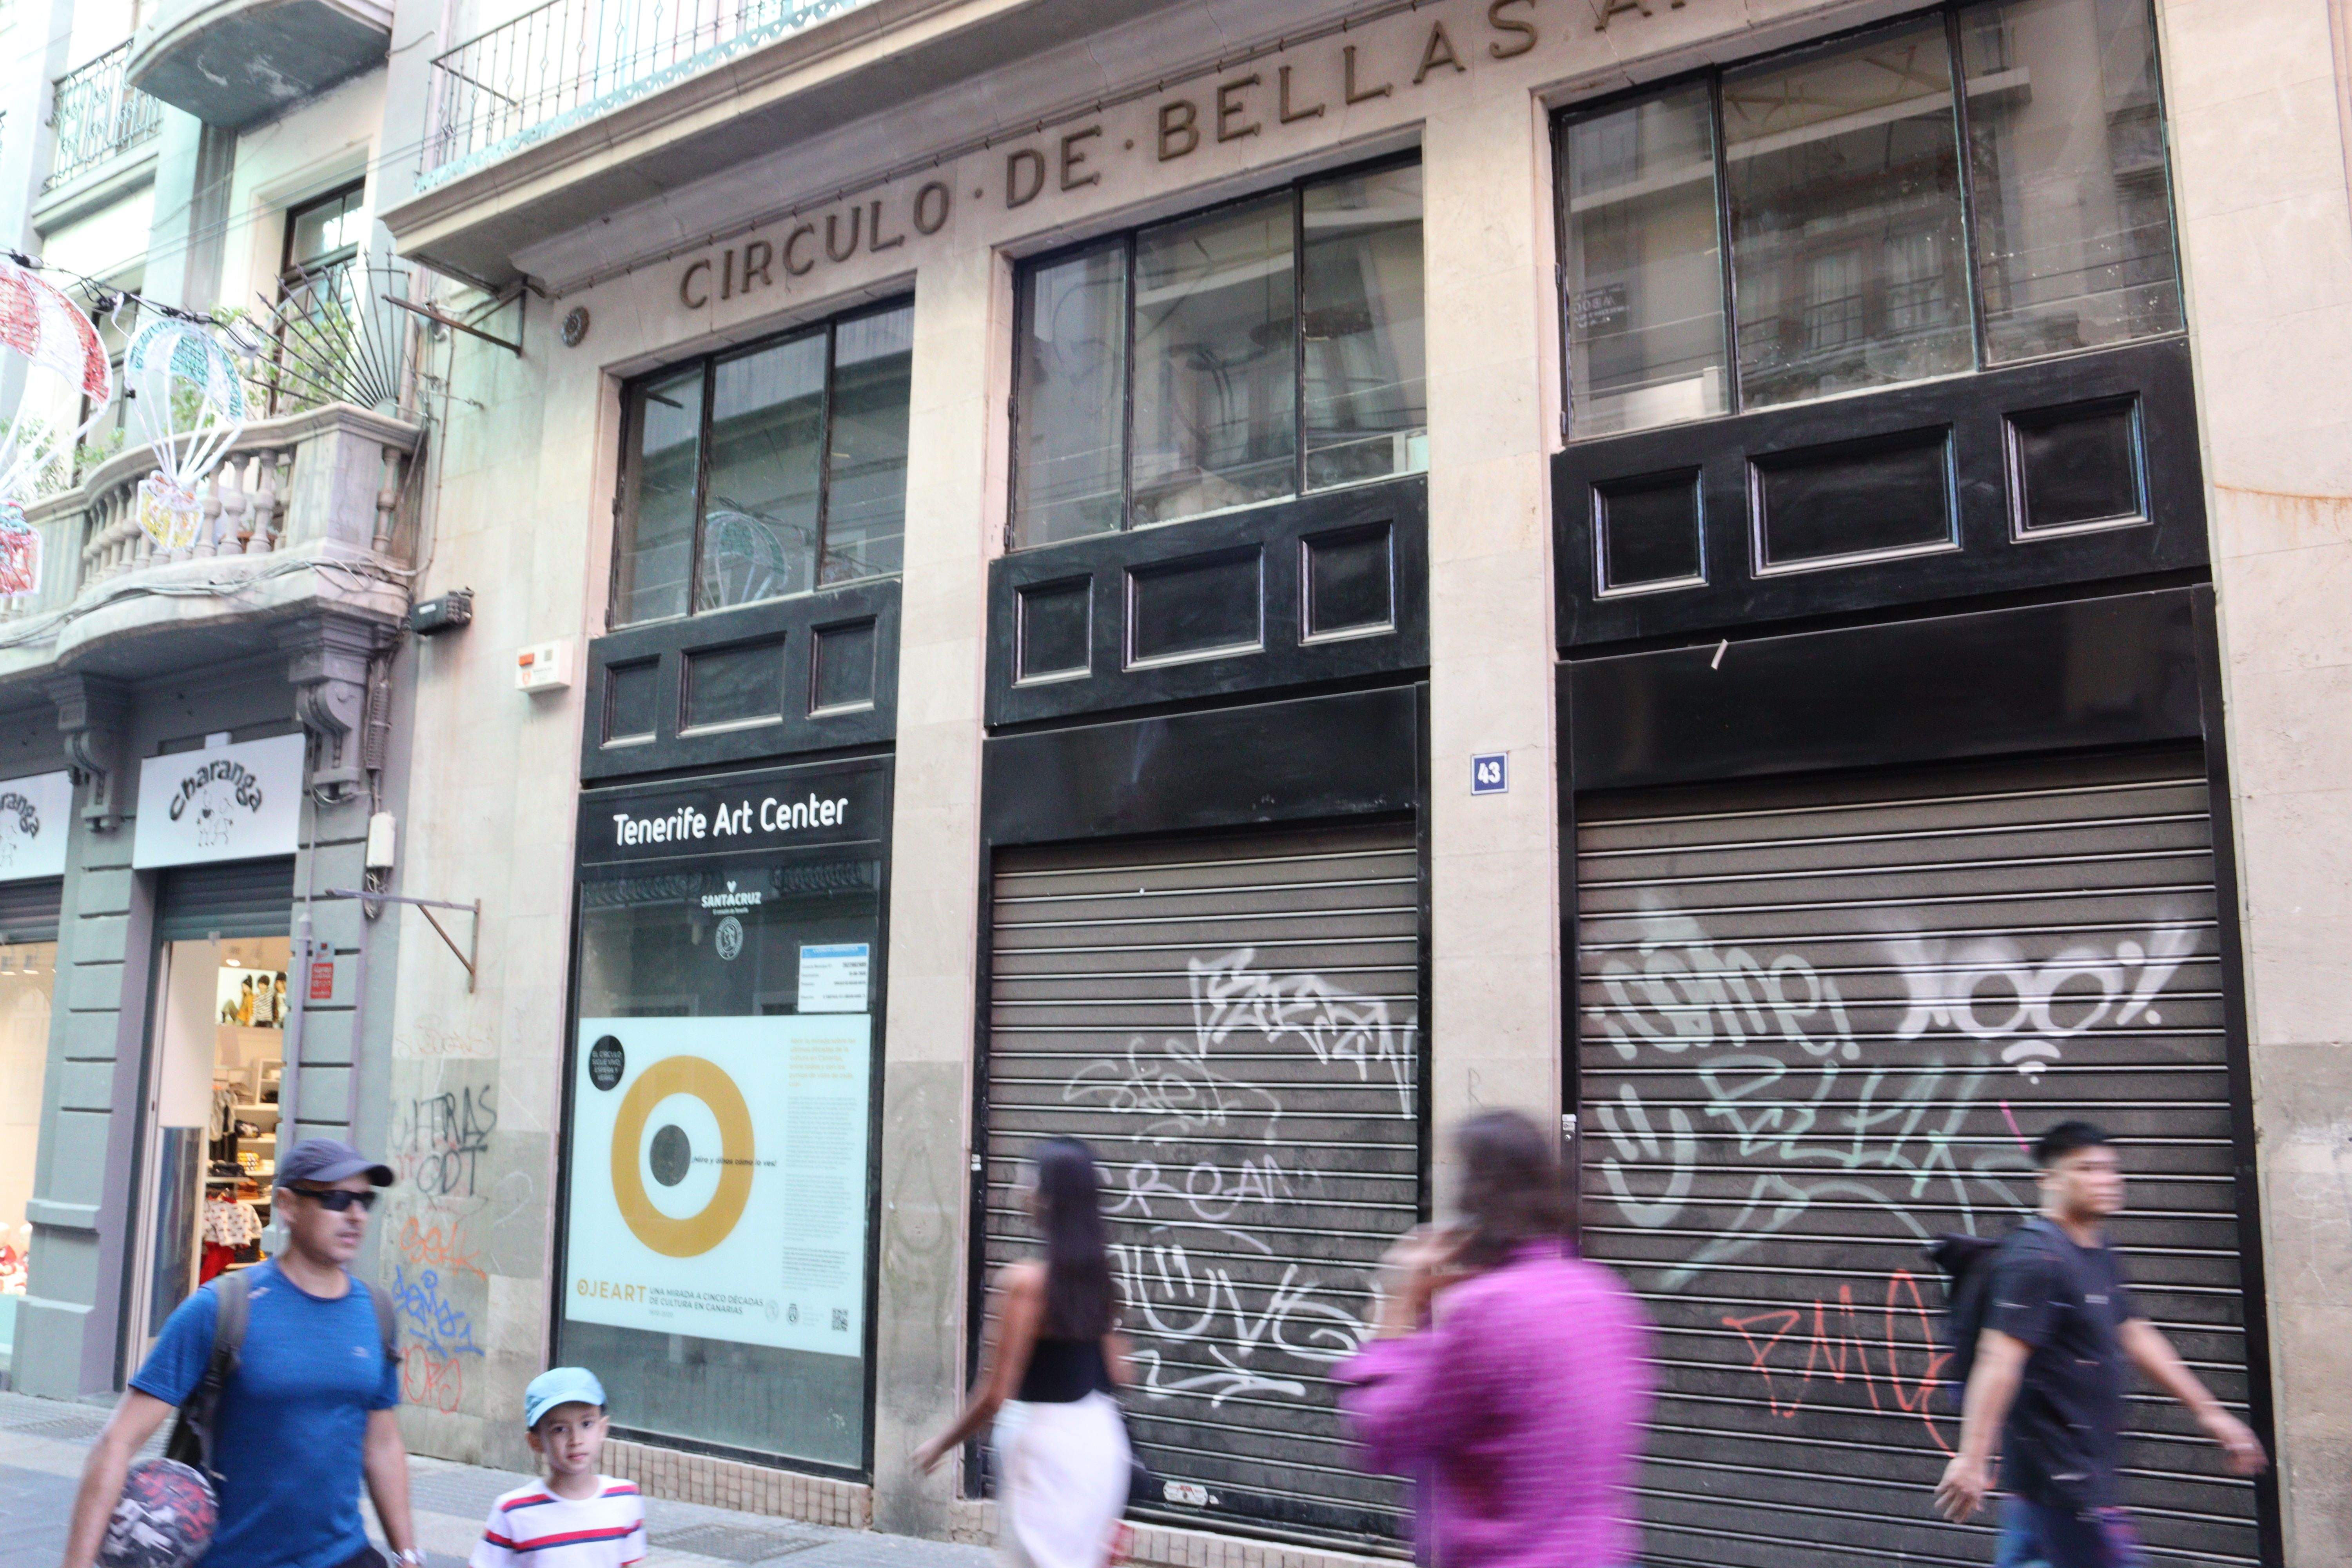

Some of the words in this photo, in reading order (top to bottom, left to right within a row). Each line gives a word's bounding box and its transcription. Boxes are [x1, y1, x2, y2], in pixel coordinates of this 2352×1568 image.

[679, 181, 949, 310] CIRCULO
[1006, 126, 1102, 209] DE
[1158, 0, 1539, 161] BELLAS
[170, 760, 262, 821] charanga
[1477, 761, 1501, 784] 43
[613, 806, 707, 846] Tenerife
[713, 800, 753, 837] Art
[760, 792, 849, 832] Center
[649, 1287, 665, 1296] UNA
[666, 1289, 694, 1299] MIRADA
[703, 1292, 726, 1303] CINCO
[728, 1294, 763, 1307] DÉCADAS
[649, 1296, 659, 1305] DE
[660, 1297, 692, 1308] CULTURA
[694, 1301, 704, 1310] EN
[705, 1303, 743, 1315] CANARIAS
